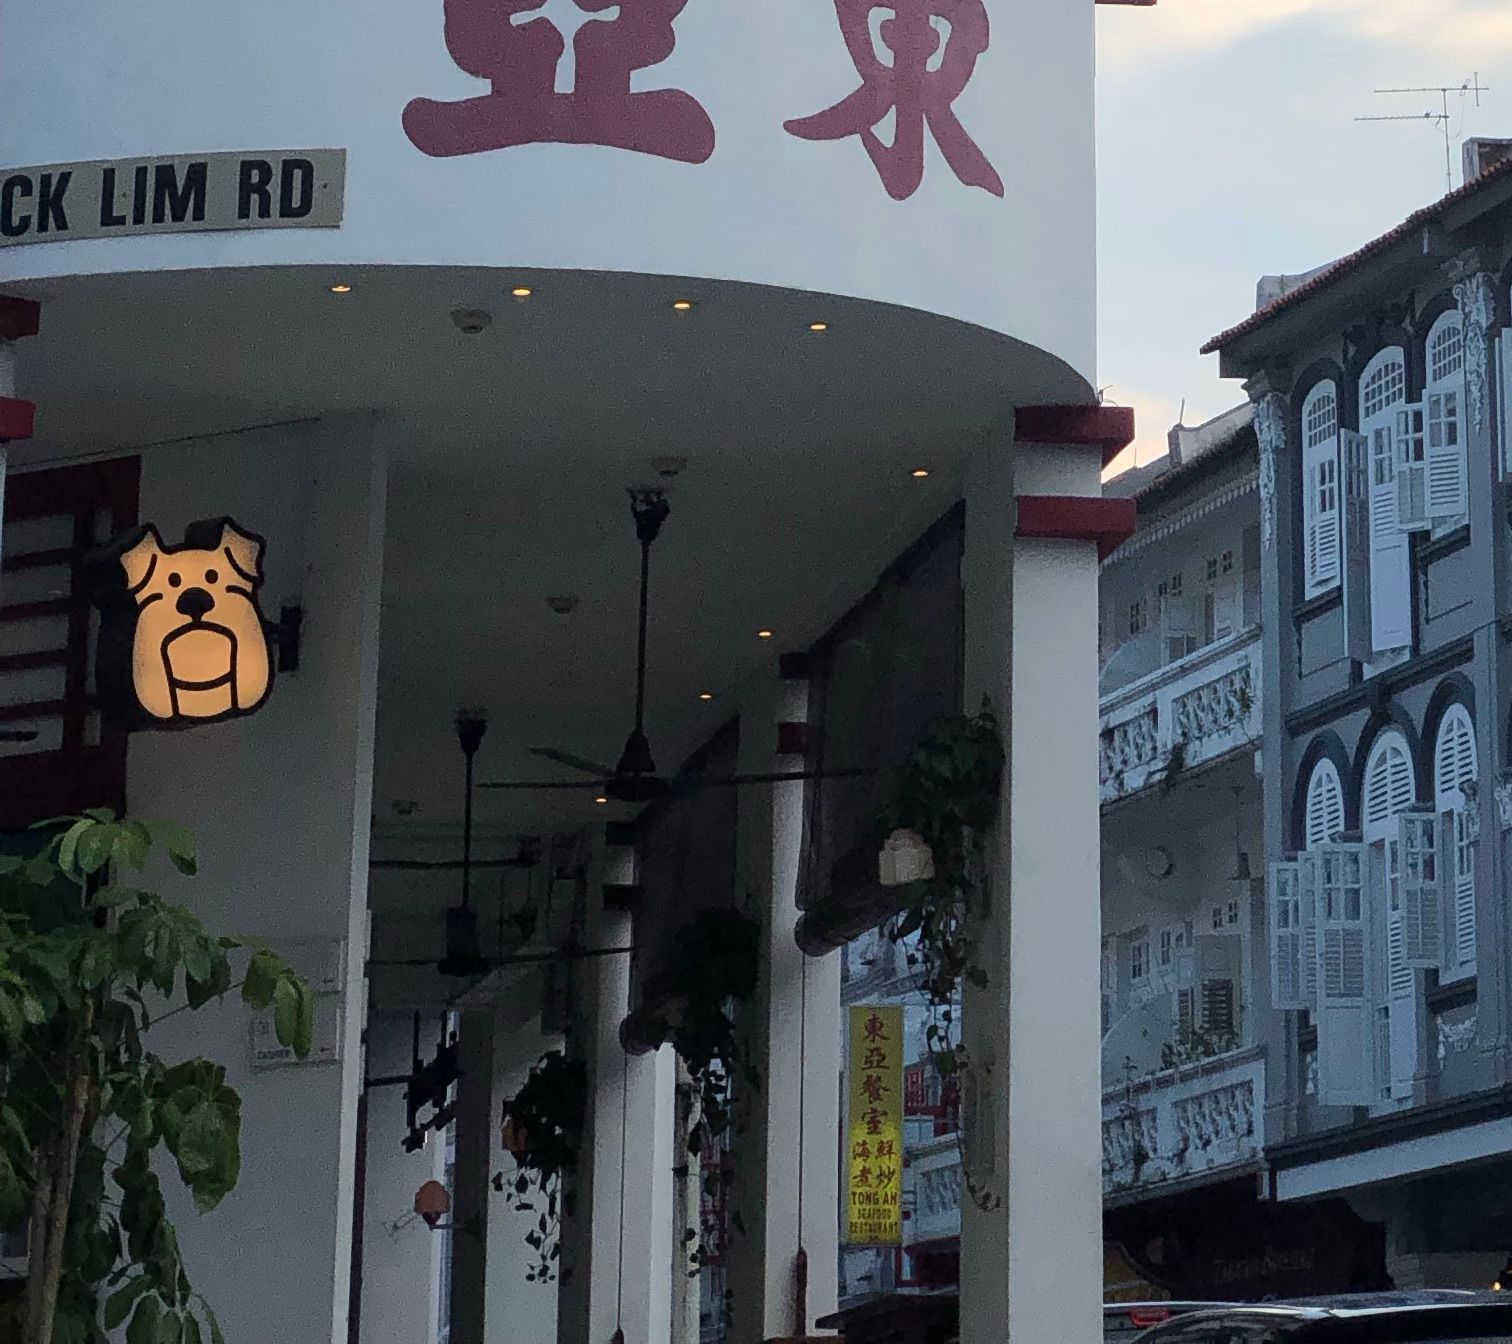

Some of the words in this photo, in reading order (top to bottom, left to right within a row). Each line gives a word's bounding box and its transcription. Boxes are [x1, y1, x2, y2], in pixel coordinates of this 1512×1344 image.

[100, 162, 208, 227] LIM
[237, 158, 315, 220] RD
[860, 1012, 891, 1137] 東亞餐室
[850, 1190, 880, 1205] TONG
[882, 1190, 898, 1206] AH
[858, 1208, 892, 1220] SEAFOOD
[849, 1222, 898, 1234] RESTAURANT
